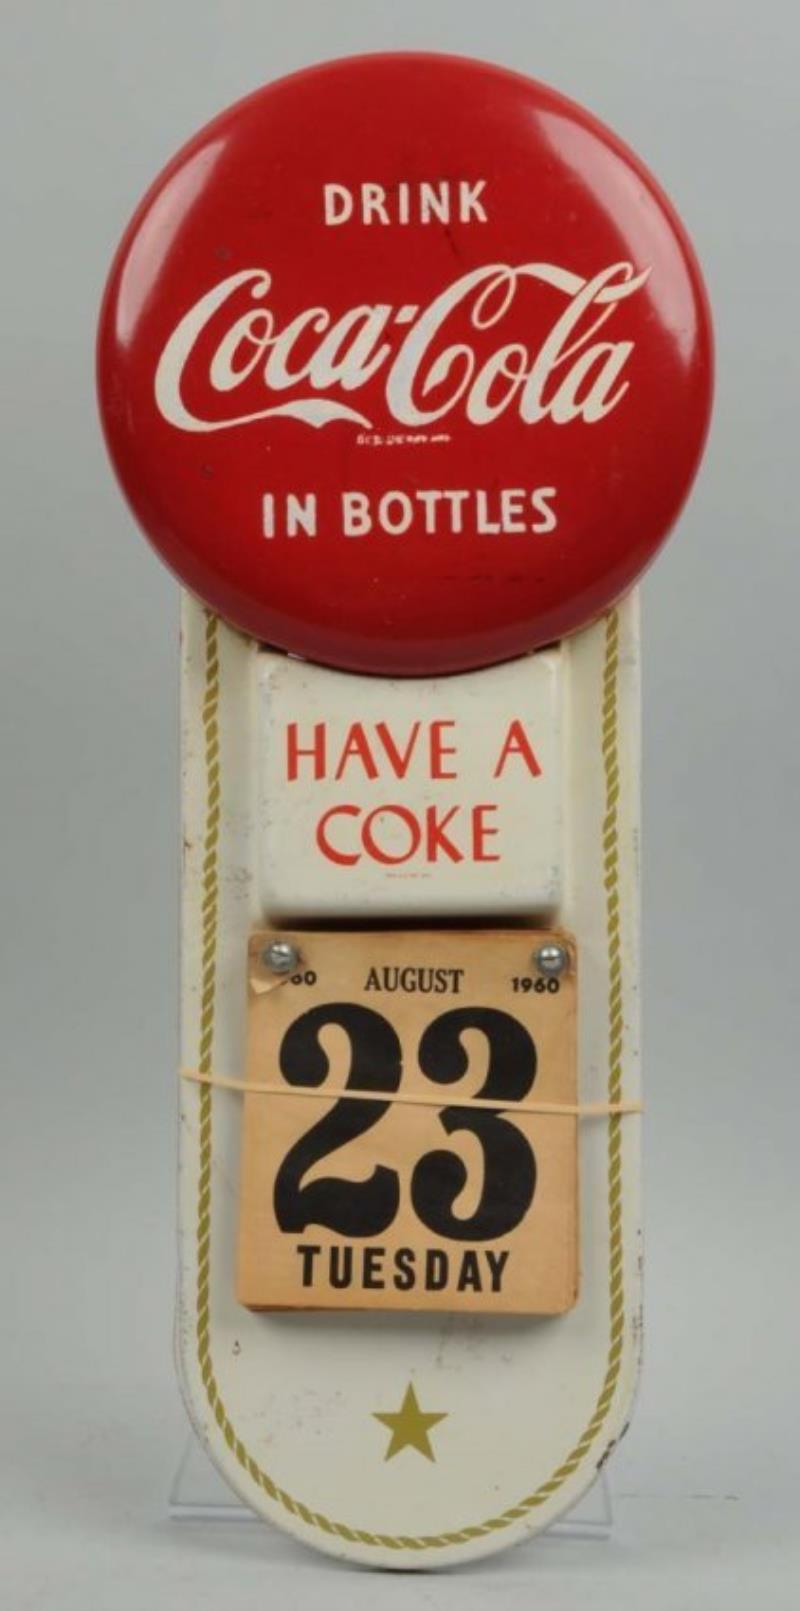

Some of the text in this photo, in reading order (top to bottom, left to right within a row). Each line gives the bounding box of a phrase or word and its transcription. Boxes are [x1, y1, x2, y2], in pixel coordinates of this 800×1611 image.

[323, 180, 488, 226] DRINK
[154, 262, 652, 432] Coca-Cola
[262, 486, 557, 539] IN BOTTLES
[286, 719, 542, 781] HAVE A
[315, 804, 500, 867] COKE
[364, 967, 464, 994] AUGUST
[512, 976, 560, 994] 1960
[273, 1002, 538, 1242] 23
[296, 1244, 509, 1293] TUESDAY
